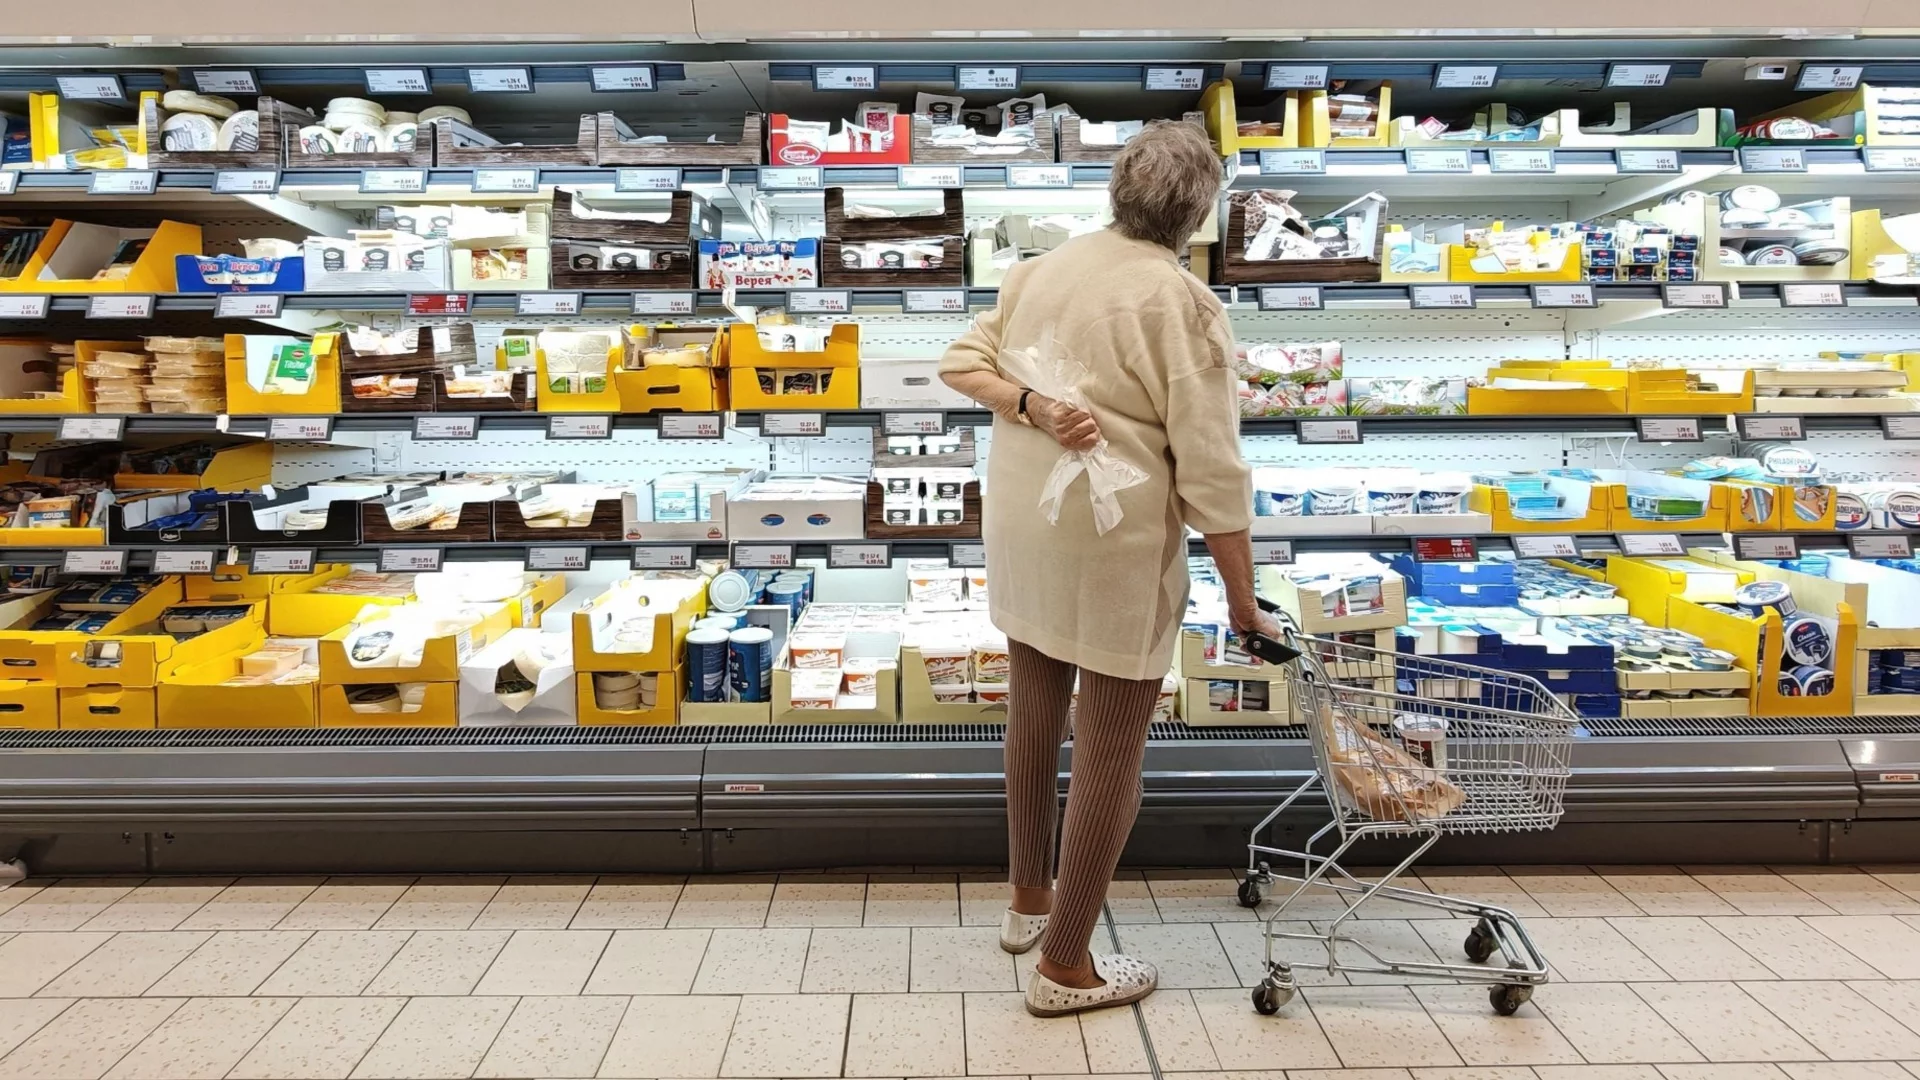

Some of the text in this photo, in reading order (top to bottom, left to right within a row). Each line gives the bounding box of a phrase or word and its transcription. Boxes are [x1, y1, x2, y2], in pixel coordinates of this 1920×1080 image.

[735, 276, 772, 288] Верея
[1768, 456, 1812, 464] PHILADELPHIA
[1888, 504, 1920, 512] PHILADELP
